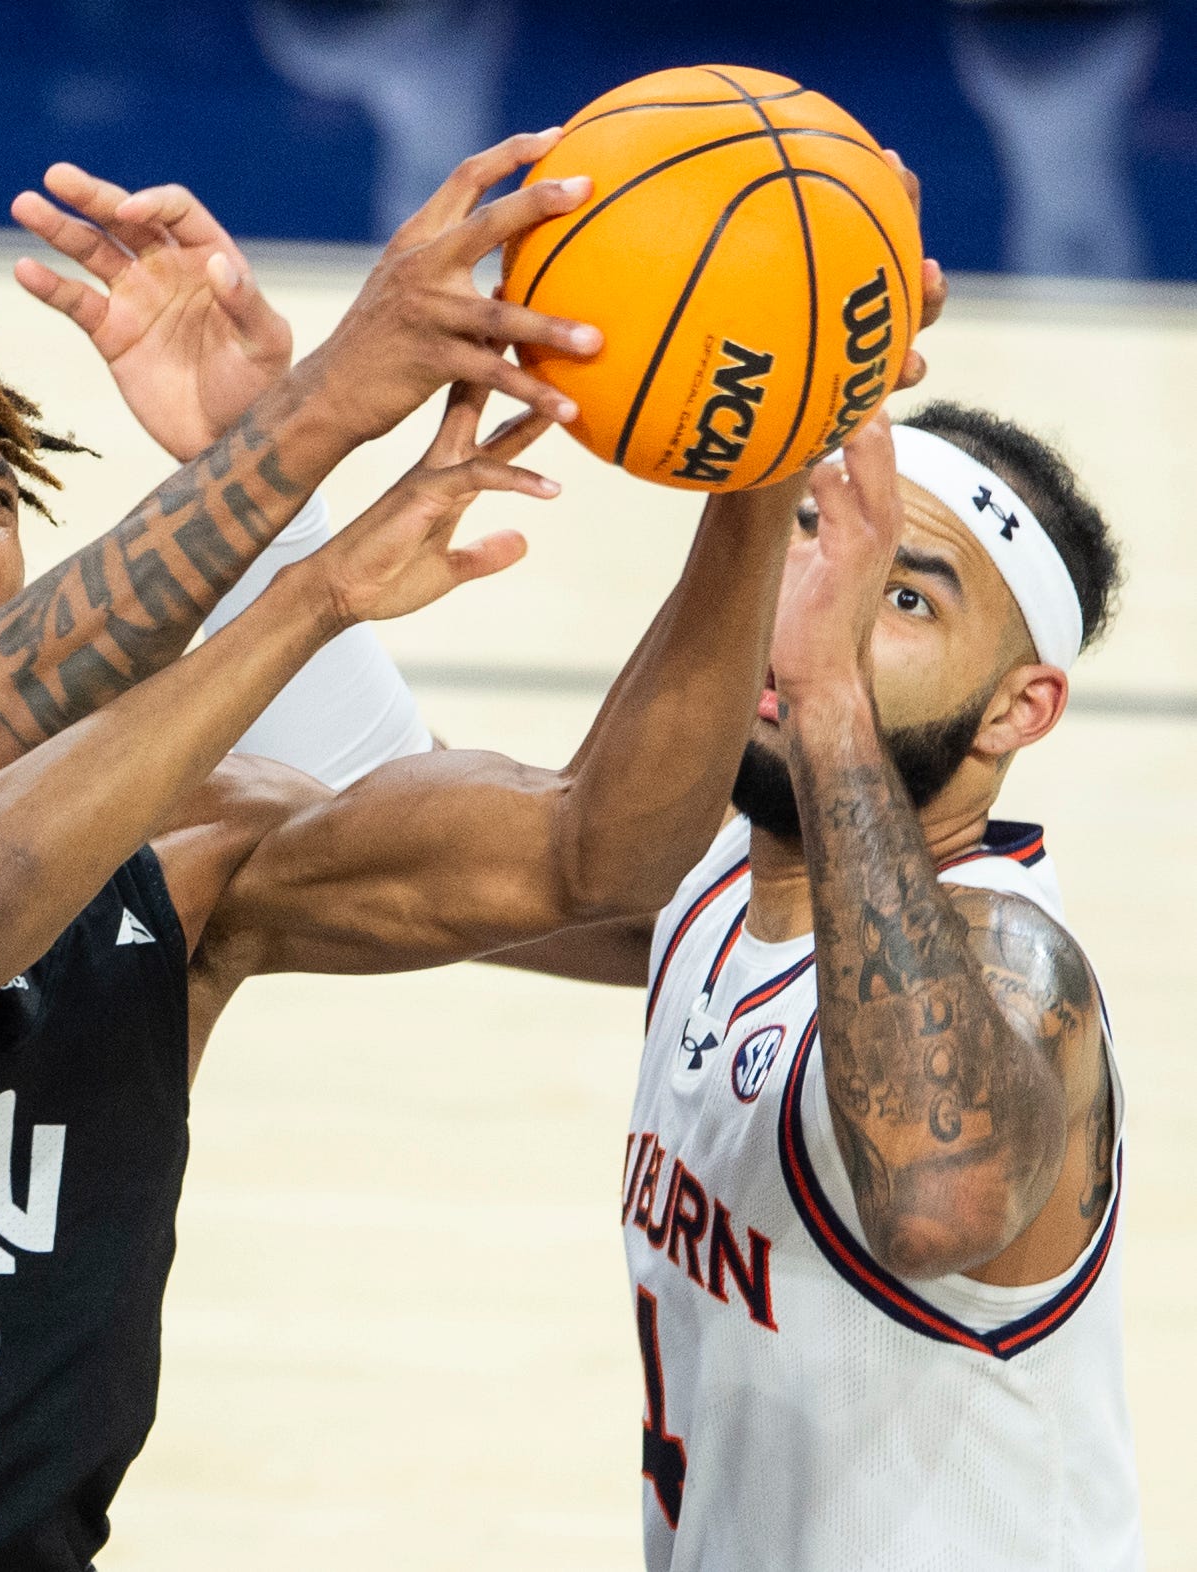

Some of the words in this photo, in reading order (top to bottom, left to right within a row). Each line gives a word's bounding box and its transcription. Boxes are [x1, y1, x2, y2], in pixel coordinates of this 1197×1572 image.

[671, 337, 776, 482] NCAA
[735, 1028, 783, 1099] SEC
[621, 1132, 780, 1334] UBURN
